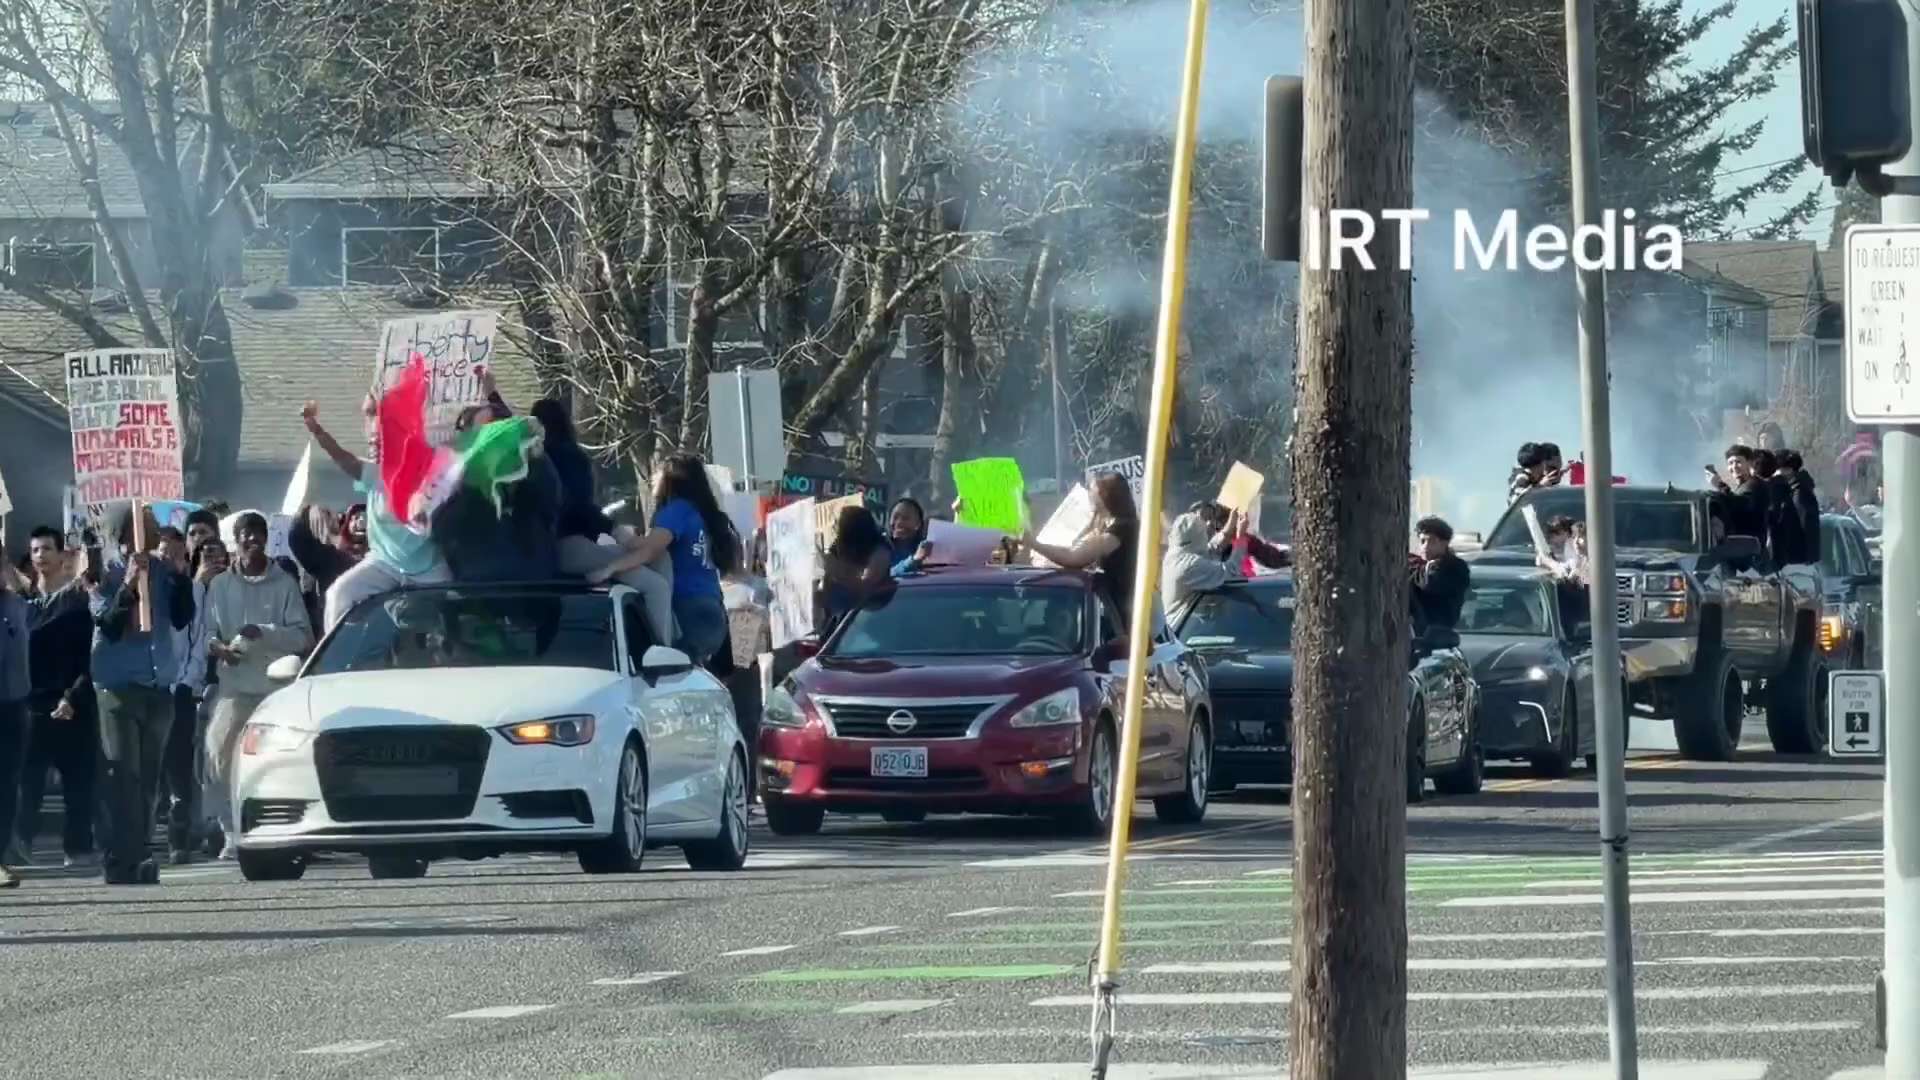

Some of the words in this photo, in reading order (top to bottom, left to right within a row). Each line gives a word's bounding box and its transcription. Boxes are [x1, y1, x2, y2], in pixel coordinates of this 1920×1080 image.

[1857, 248, 1868, 268] TO
[1871, 280, 1905, 301] GREEN
[1858, 328, 1883, 345] WAIT
[70, 354, 107, 378] ALL
[109, 352, 176, 376] ANIMALS
[1865, 361, 1878, 380] ON
[71, 403, 117, 431] BUT
[119, 402, 172, 425] SOME
[74, 427, 162, 451] ANIMALS
[76, 451, 127, 474] MORE
[130, 450, 180, 472] EQUAL
[80, 473, 128, 503] THAN
